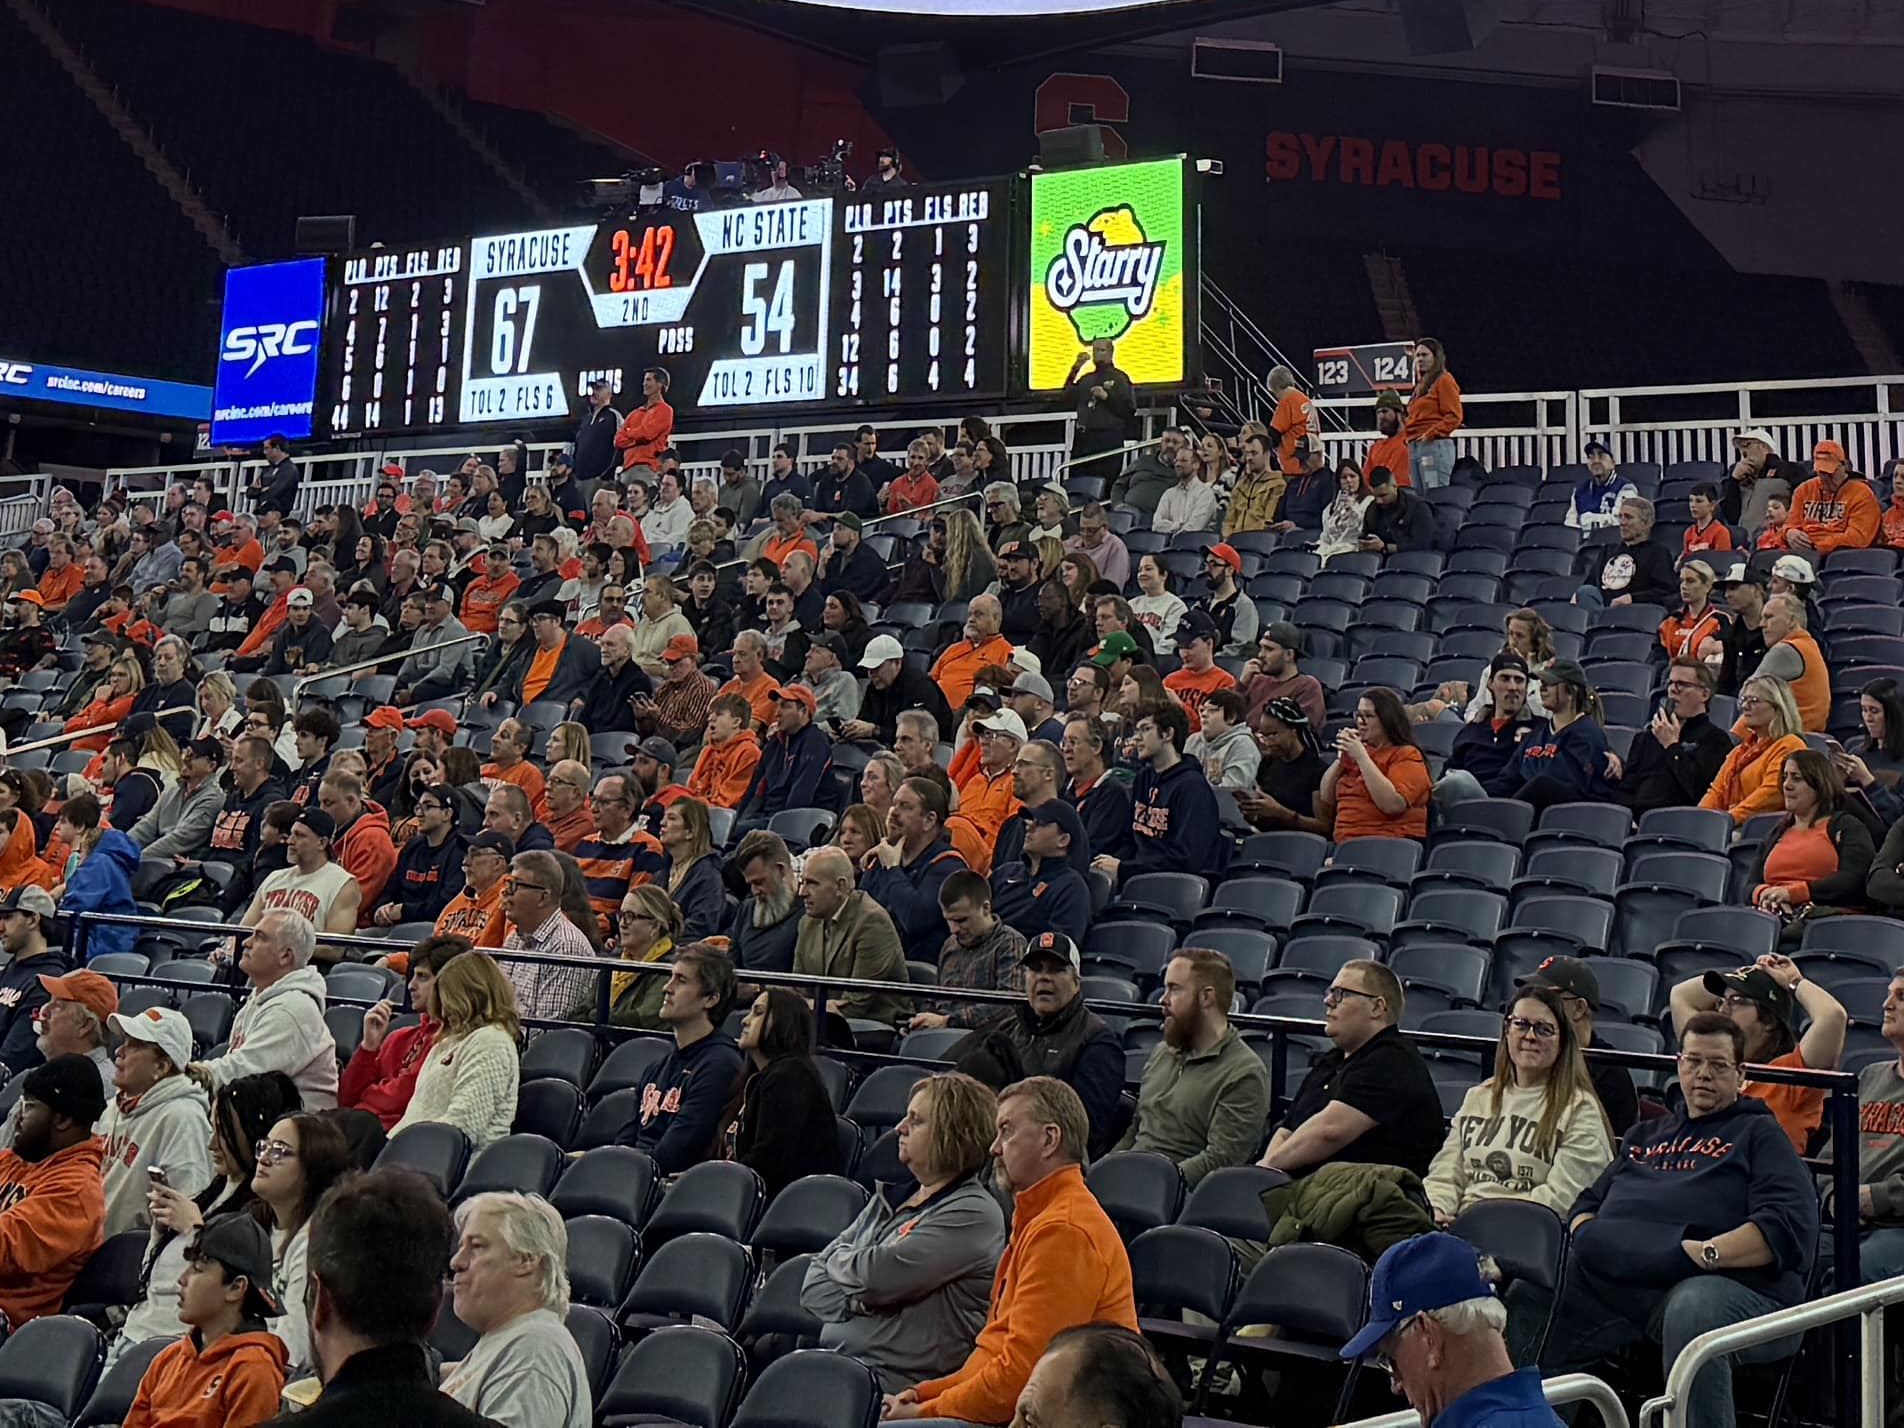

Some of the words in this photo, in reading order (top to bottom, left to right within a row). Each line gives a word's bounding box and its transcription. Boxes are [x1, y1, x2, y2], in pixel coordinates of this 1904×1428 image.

[1265, 132, 1561, 199] SYRACUSE
[723, 213, 744, 248] NC
[754, 206, 808, 244] STATE
[853, 234, 863, 263] 2
[892, 231, 902, 259] 2
[967, 224, 978, 253] 3
[487, 233, 571, 273] SYRACUSE
[610, 225, 675, 292] 3:42
[1047, 227, 1165, 313] Starry
[852, 271, 862, 300] 3
[883, 267, 901, 297] 14
[931, 264, 941, 292] 3
[967, 261, 977, 290] 2
[622, 299, 649, 322] 2ND
[741, 259, 795, 355] 54
[491, 285, 541, 374] 67
[658, 327, 694, 354] POSS
[842, 333, 859, 362] 12
[965, 325, 975, 355] 2
[222, 320, 317, 379] SRC
[713, 371, 737, 399] TOL
[745, 370, 752, 395] 2
[765, 367, 791, 394] FLS
[800, 366, 814, 393] 10
[837, 366, 858, 396] 34
[928, 361, 939, 391] 4
[964, 358, 975, 388] 4
[1317, 358, 1349, 385] 123
[1372, 356, 1409, 382] 124
[471, 390, 491, 415] TOL
[498, 388, 506, 412] 2
[516, 386, 539, 412] FLS
[546, 385, 554, 410] 6
